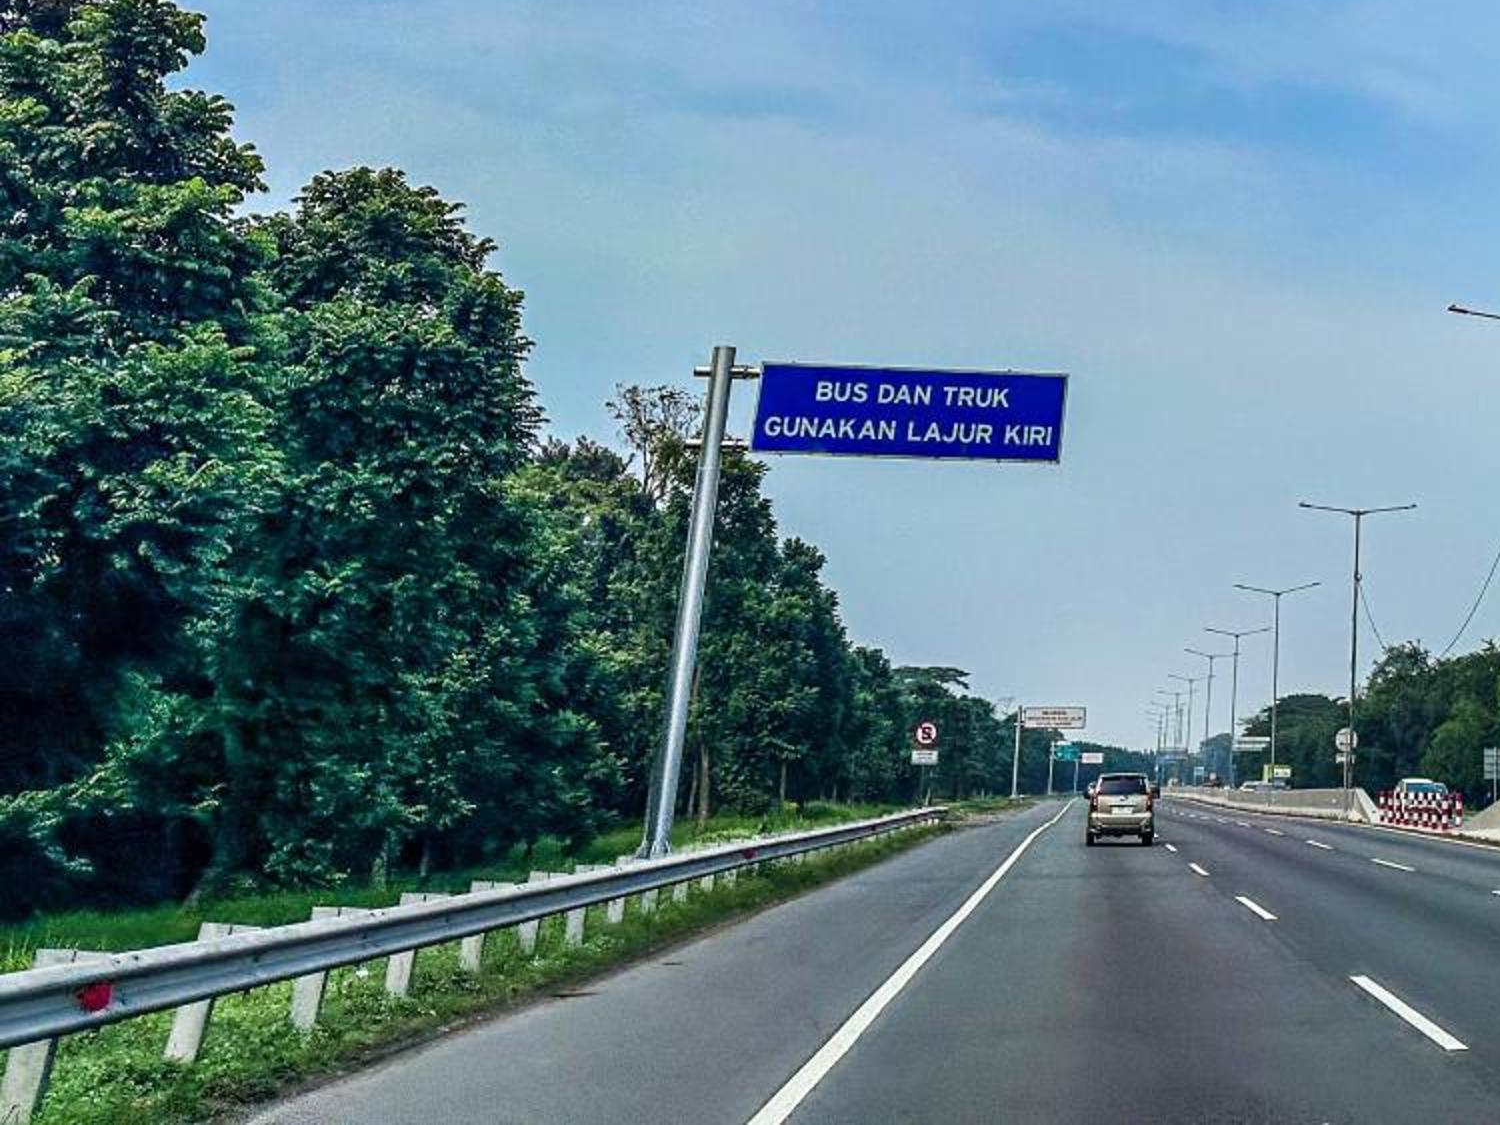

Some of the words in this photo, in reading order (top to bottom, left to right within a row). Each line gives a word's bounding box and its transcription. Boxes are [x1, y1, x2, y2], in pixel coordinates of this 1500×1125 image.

[815, 380, 869, 403] BUS
[877, 383, 932, 406] DAN
[944, 385, 1010, 409] TRUK
[764, 416, 897, 441] GUNAKAN
[907, 420, 993, 445] LAJUR
[1003, 423, 1053, 446] KIRI
